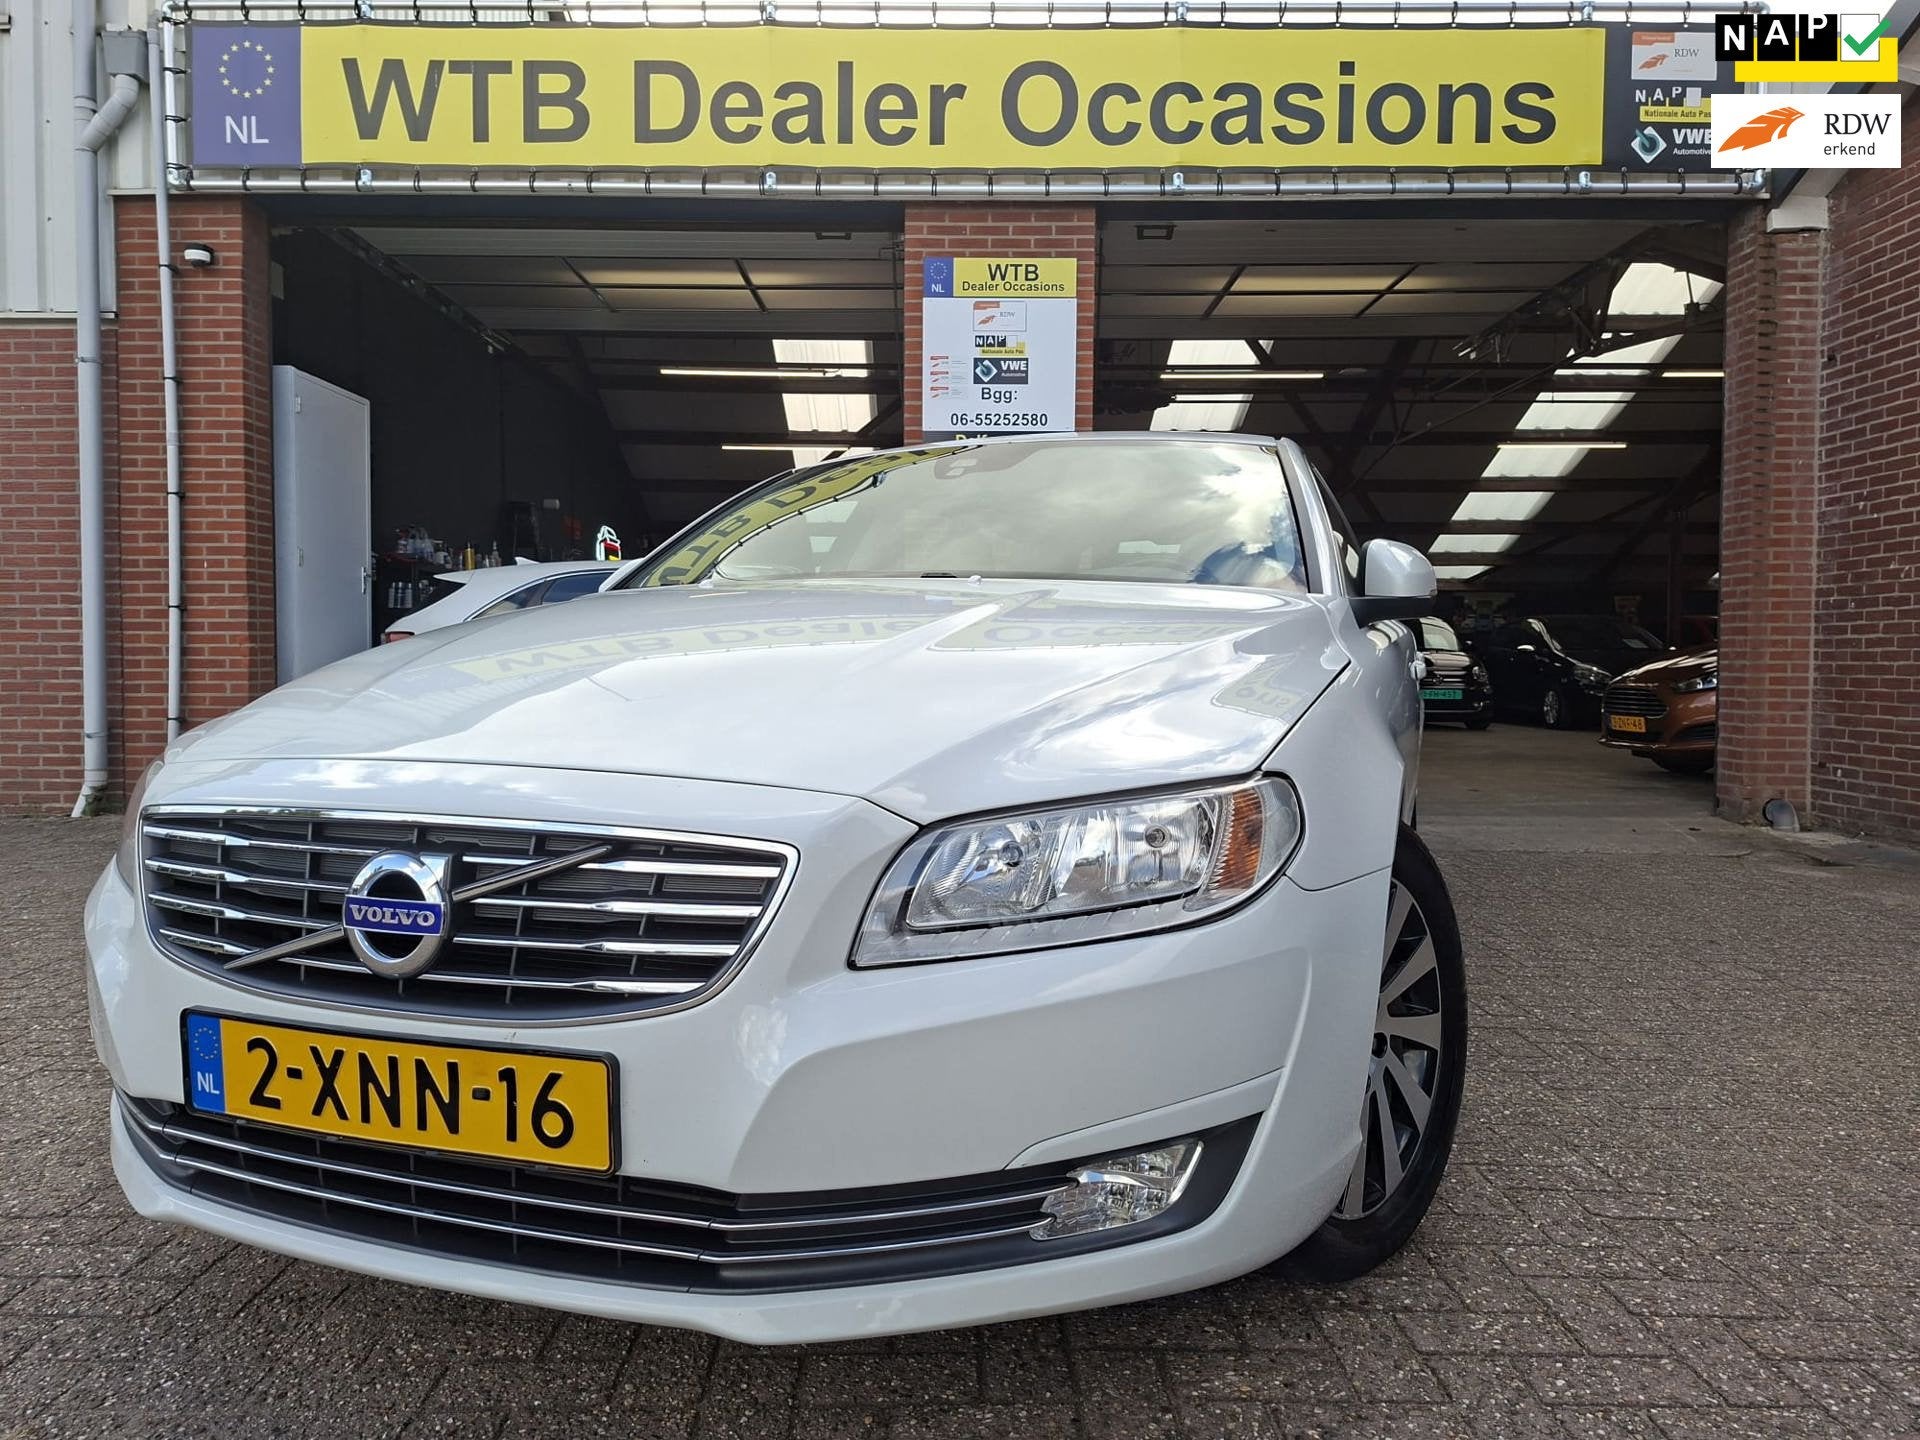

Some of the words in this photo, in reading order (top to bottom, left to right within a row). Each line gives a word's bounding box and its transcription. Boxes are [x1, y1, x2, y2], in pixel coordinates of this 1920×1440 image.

[1673, 48, 1700, 58] RDW
[341, 57, 591, 144] WTB
[633, 60, 967, 147] Dealer
[999, 60, 1557, 146] Occasions
[1643, 109, 1678, 119] Nationale
[1680, 110, 1697, 118] Auto
[224, 115, 270, 145] NL
[987, 263, 1040, 282] WTB
[931, 283, 945, 293] NL
[962, 281, 1000, 292] Dealer
[1003, 281, 1065, 292] Occasions
[1000, 360, 1028, 371] VWE
[981, 386, 1018, 404] Bgg:
[950, 413, 1049, 427] 06-55252580
[348, 903, 437, 928] VOLVO
[196, 1070, 221, 1096] NL
[245, 1035, 576, 1150] 2-XNN-16
